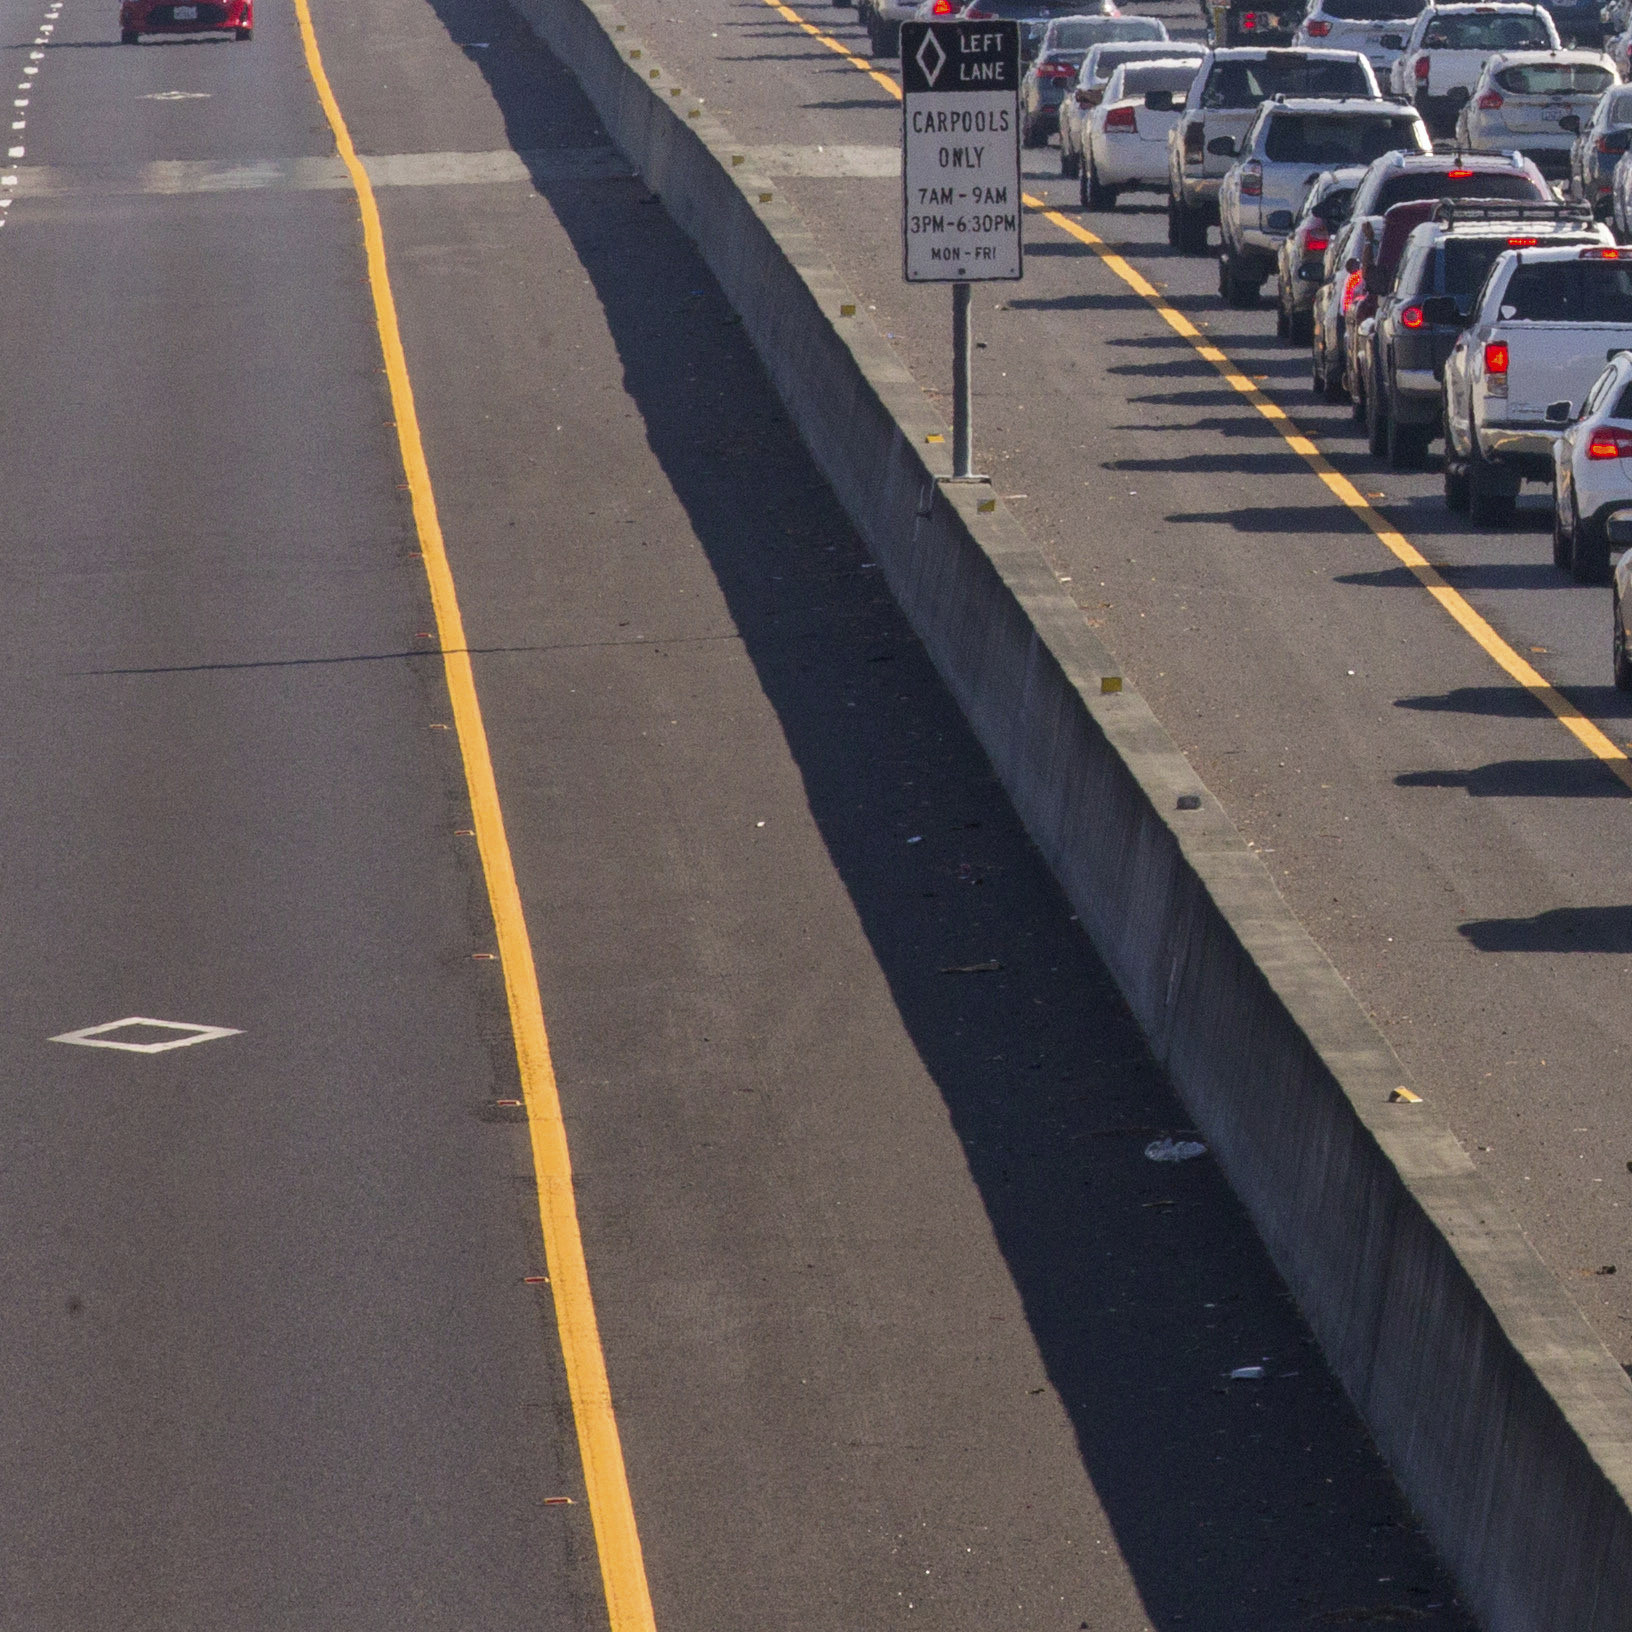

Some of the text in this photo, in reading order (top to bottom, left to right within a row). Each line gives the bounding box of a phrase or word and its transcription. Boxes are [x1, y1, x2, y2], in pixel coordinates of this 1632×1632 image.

[960, 34, 1004, 53] LEFT
[960, 62, 1005, 81] LANE
[913, 110, 1009, 133] CARPOOLS
[939, 147, 985, 168] ONLY
[918, 187, 953, 205] 7AM
[972, 187, 1007, 204] 9AM
[931, 247, 960, 260] MON
[975, 246, 997, 260] FRI
